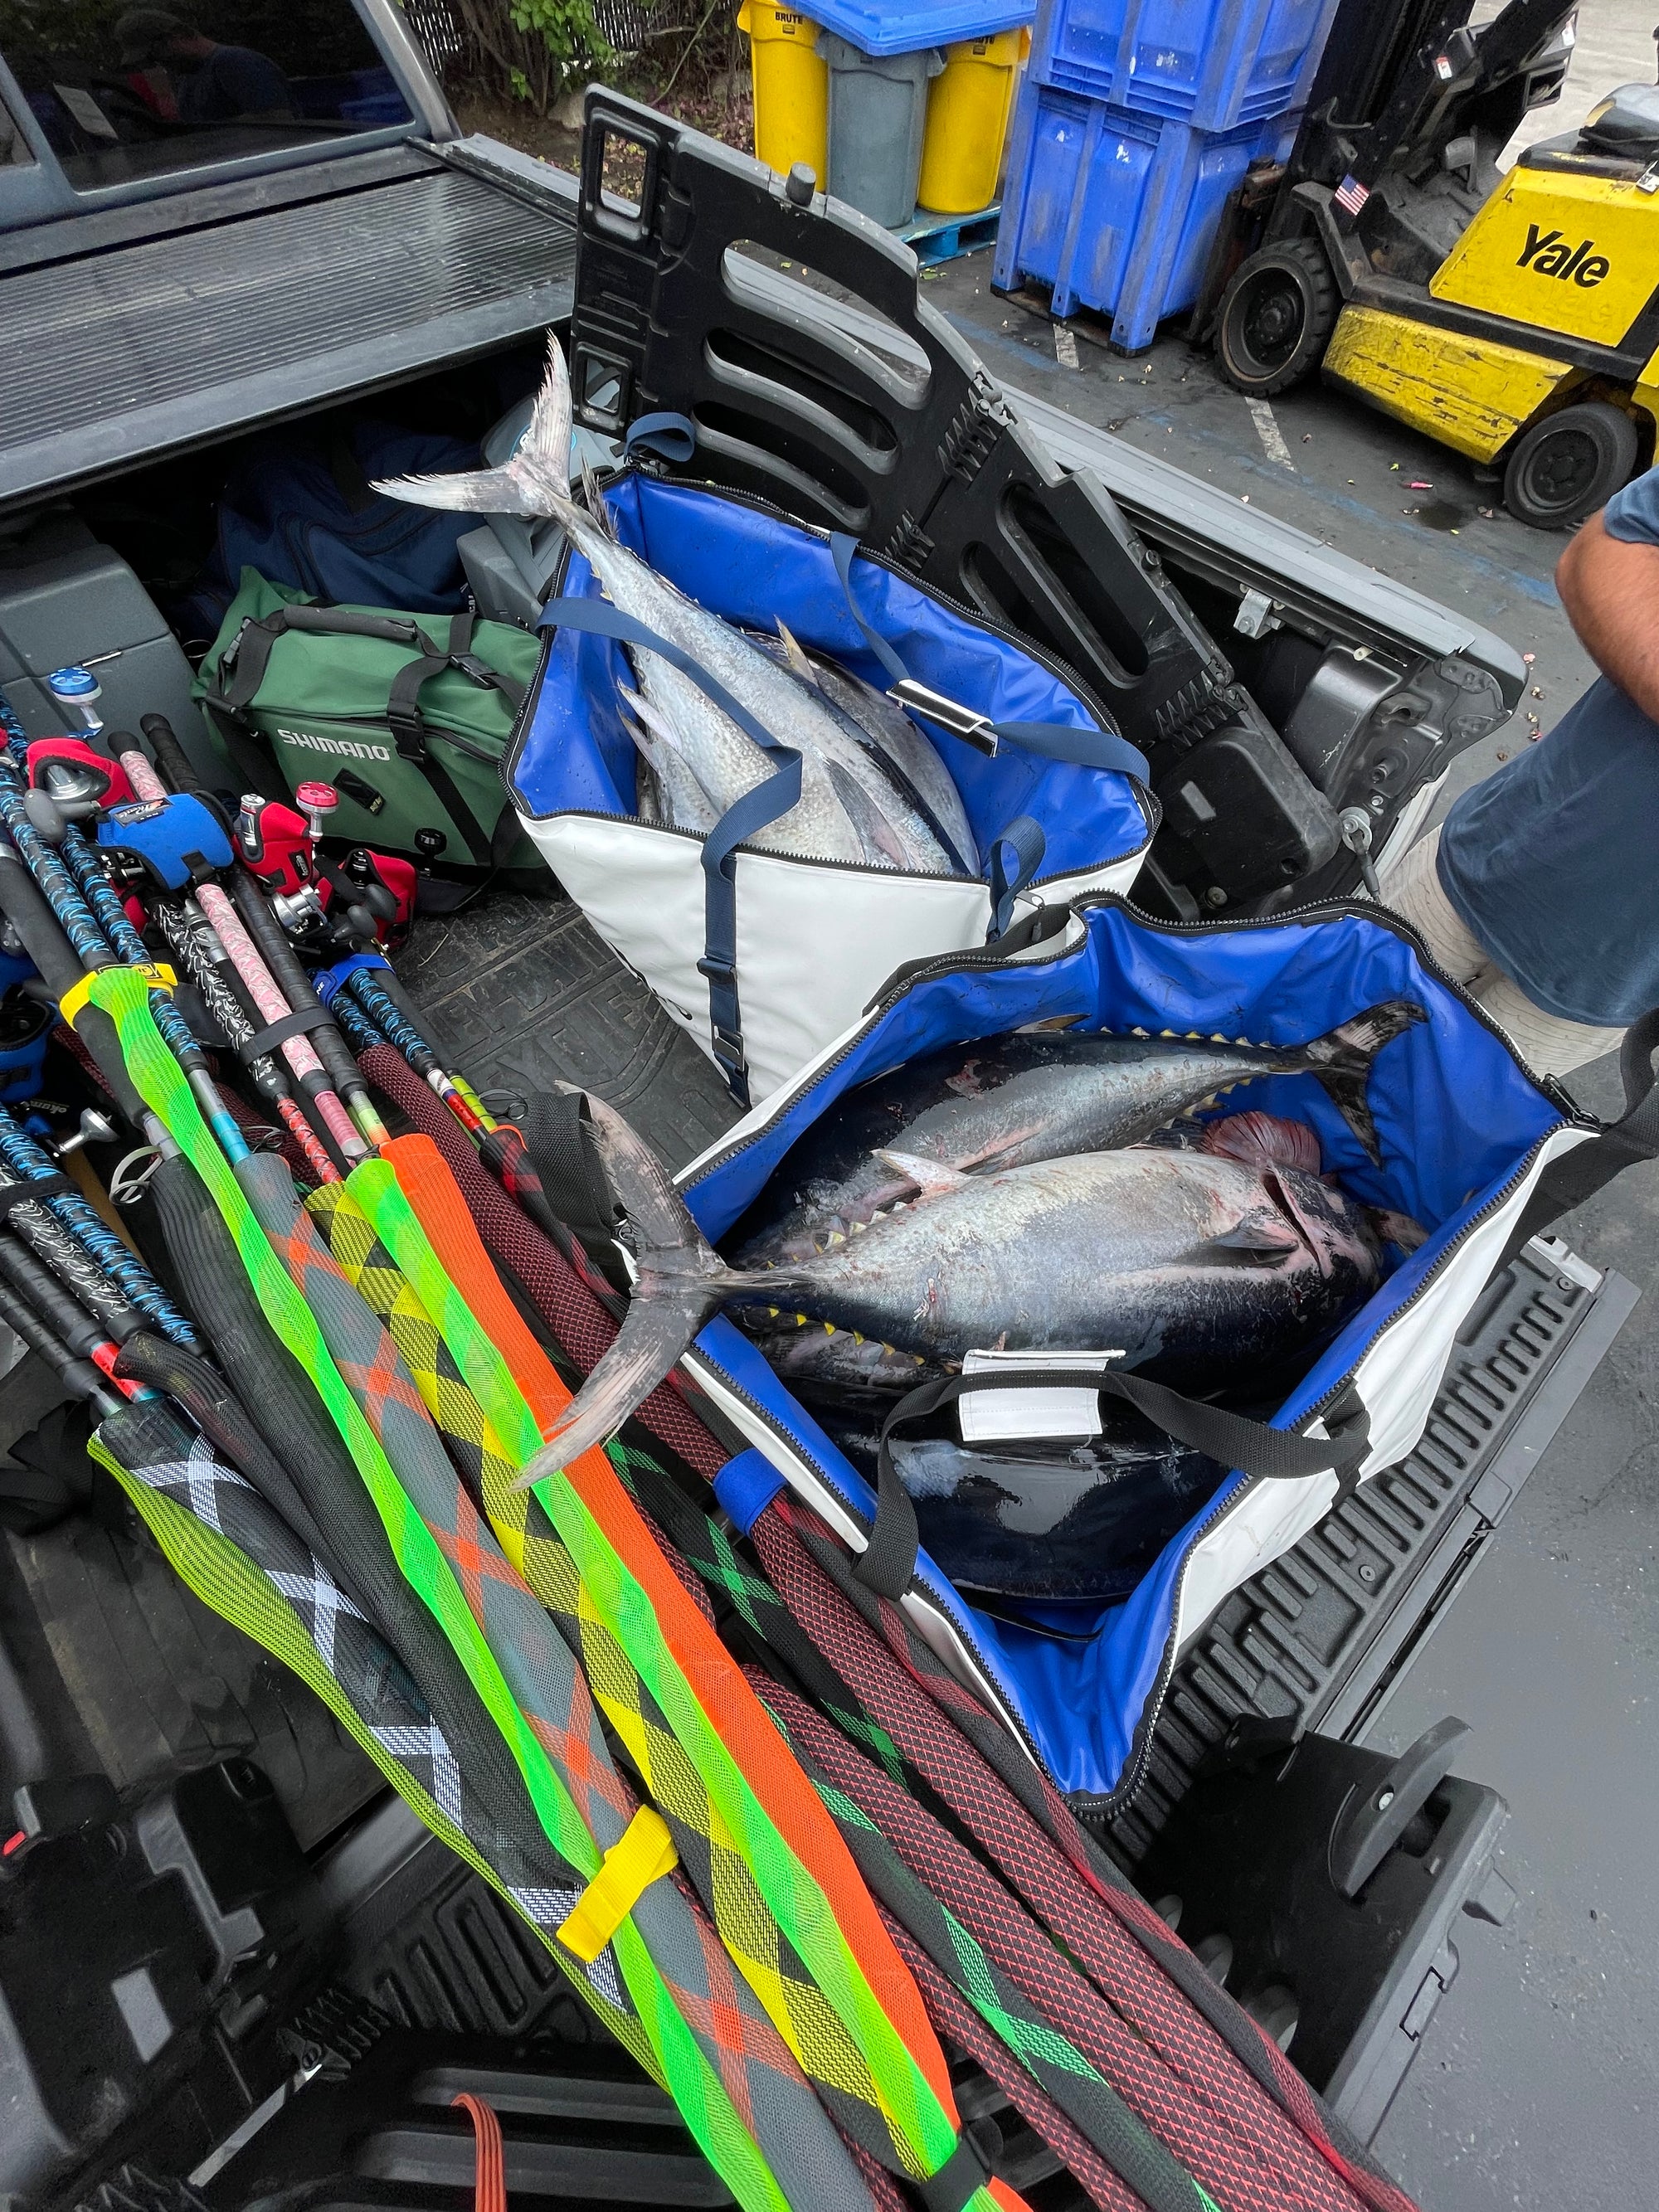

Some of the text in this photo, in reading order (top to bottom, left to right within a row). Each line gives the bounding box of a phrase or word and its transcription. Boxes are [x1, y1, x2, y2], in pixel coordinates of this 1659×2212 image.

[775, 11, 803, 25] BRUTE
[1515, 223, 1610, 288] Yale
[277, 728, 391, 761] SHIMANO
